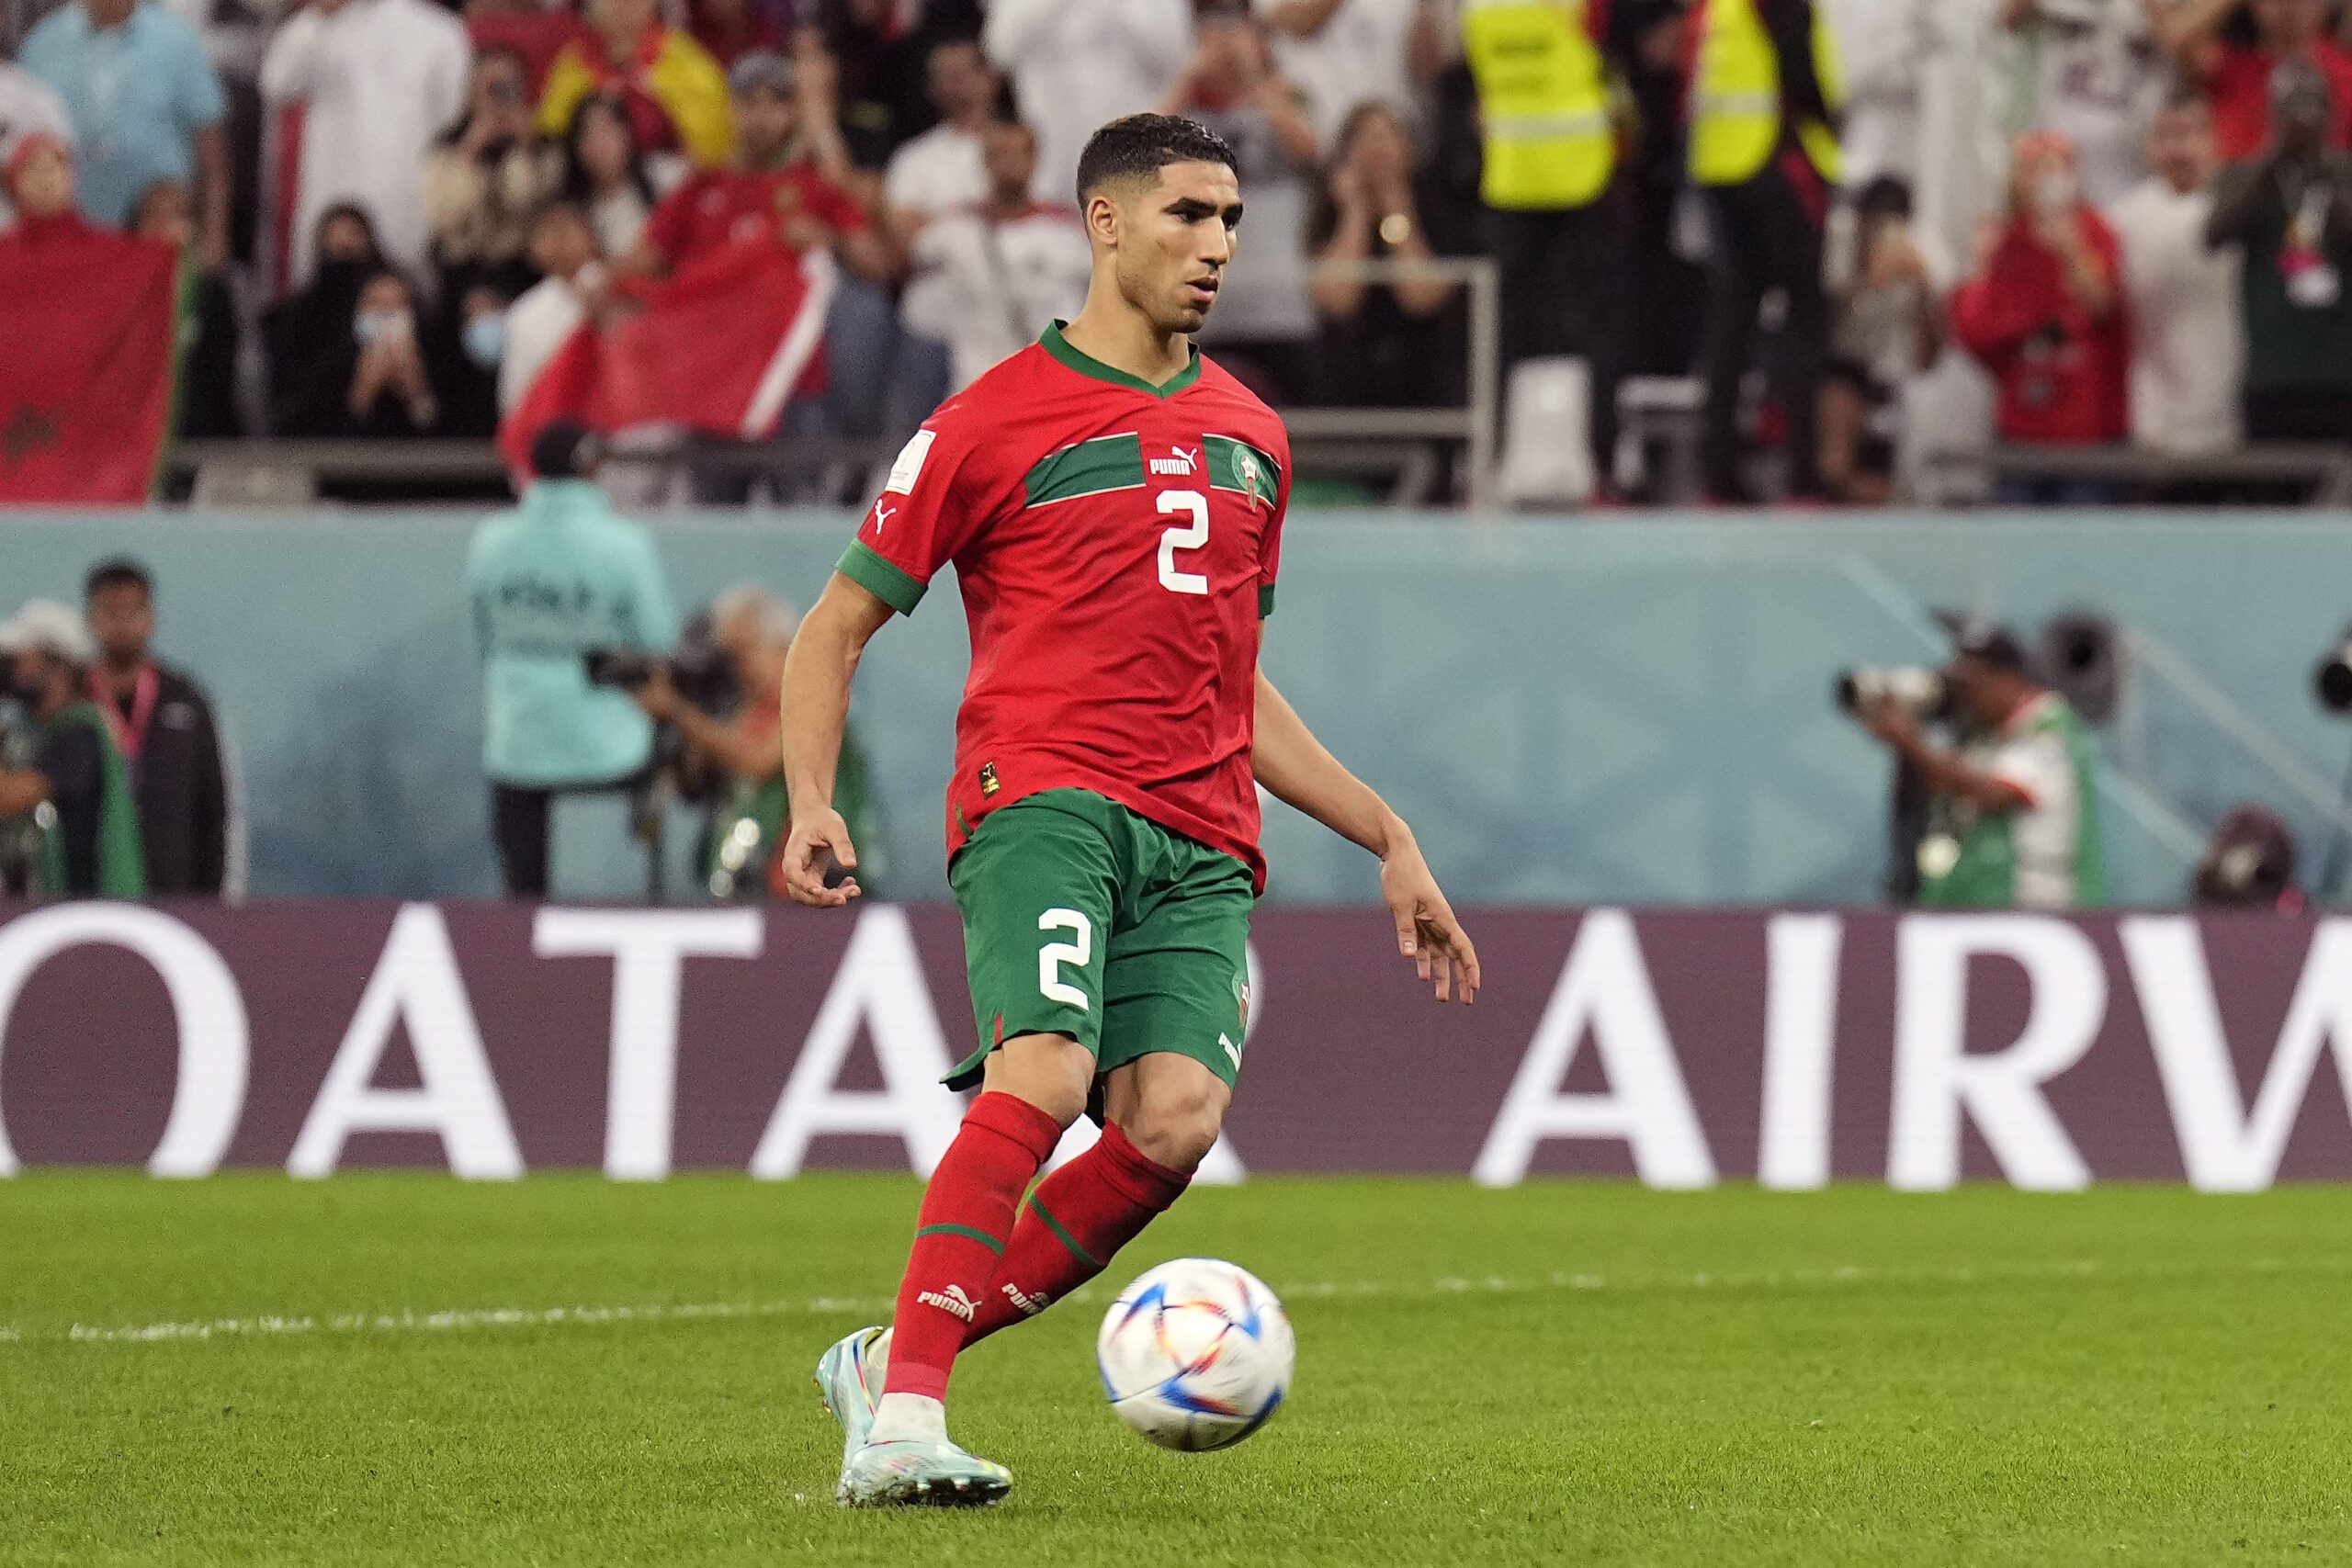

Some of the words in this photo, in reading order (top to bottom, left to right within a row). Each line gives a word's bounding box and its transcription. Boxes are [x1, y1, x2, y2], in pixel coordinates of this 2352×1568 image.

[1149, 458, 1191, 476] PUMA
[1156, 490, 1209, 595] 2
[1038, 908, 1091, 1011] 2
[1473, 907, 2352, 1193] AIRW
[917, 1291, 969, 1319] PUMA
